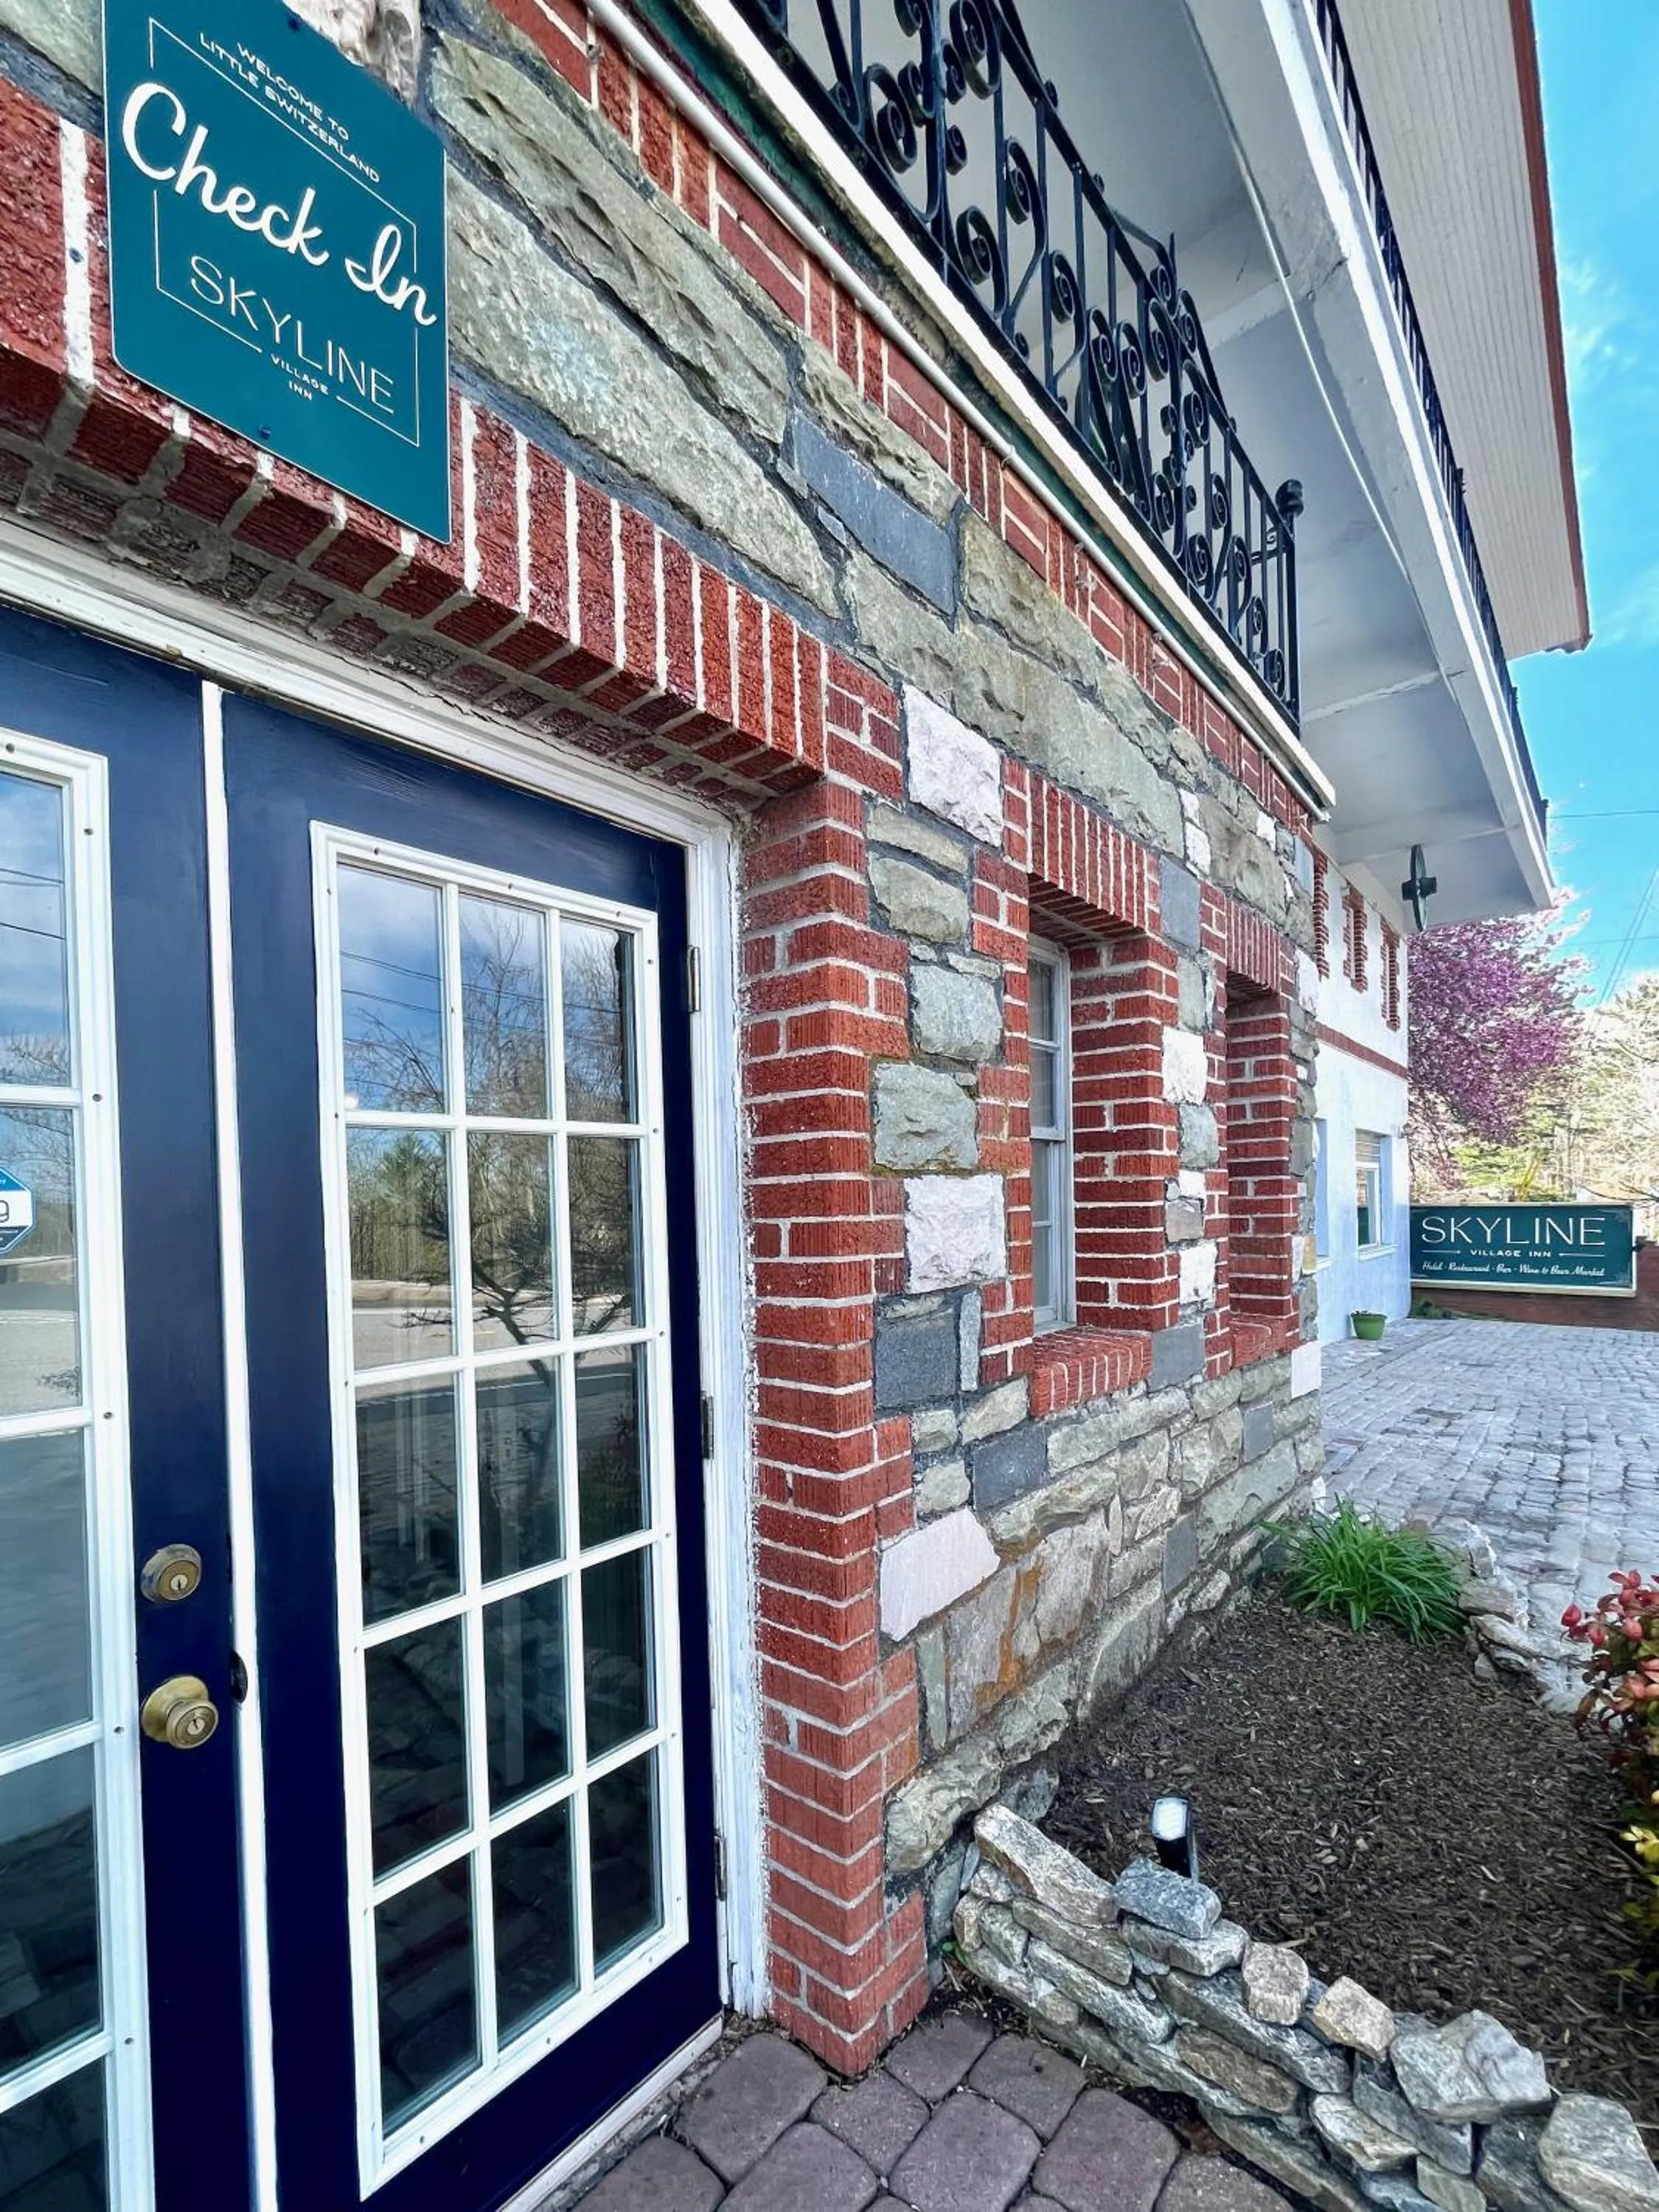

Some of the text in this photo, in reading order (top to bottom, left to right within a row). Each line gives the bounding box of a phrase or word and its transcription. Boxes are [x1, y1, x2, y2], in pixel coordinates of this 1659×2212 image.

[200, 32, 380, 183] LITTLE SWITZERLAND
[237, 41, 349, 140] WELCOME TO
[122, 82, 437, 327] Check In
[190, 255, 394, 415] SKYLINE
[271, 353, 330, 395] VILLAGE
[288, 380, 313, 401] INN
[1421, 1216, 1605, 1246] SKYLINE
[1422, 1261, 1444, 1270] Hotel
[1519, 1263, 1540, 1274] Wine
[1470, 1248, 1521, 1257] VILLAGE
